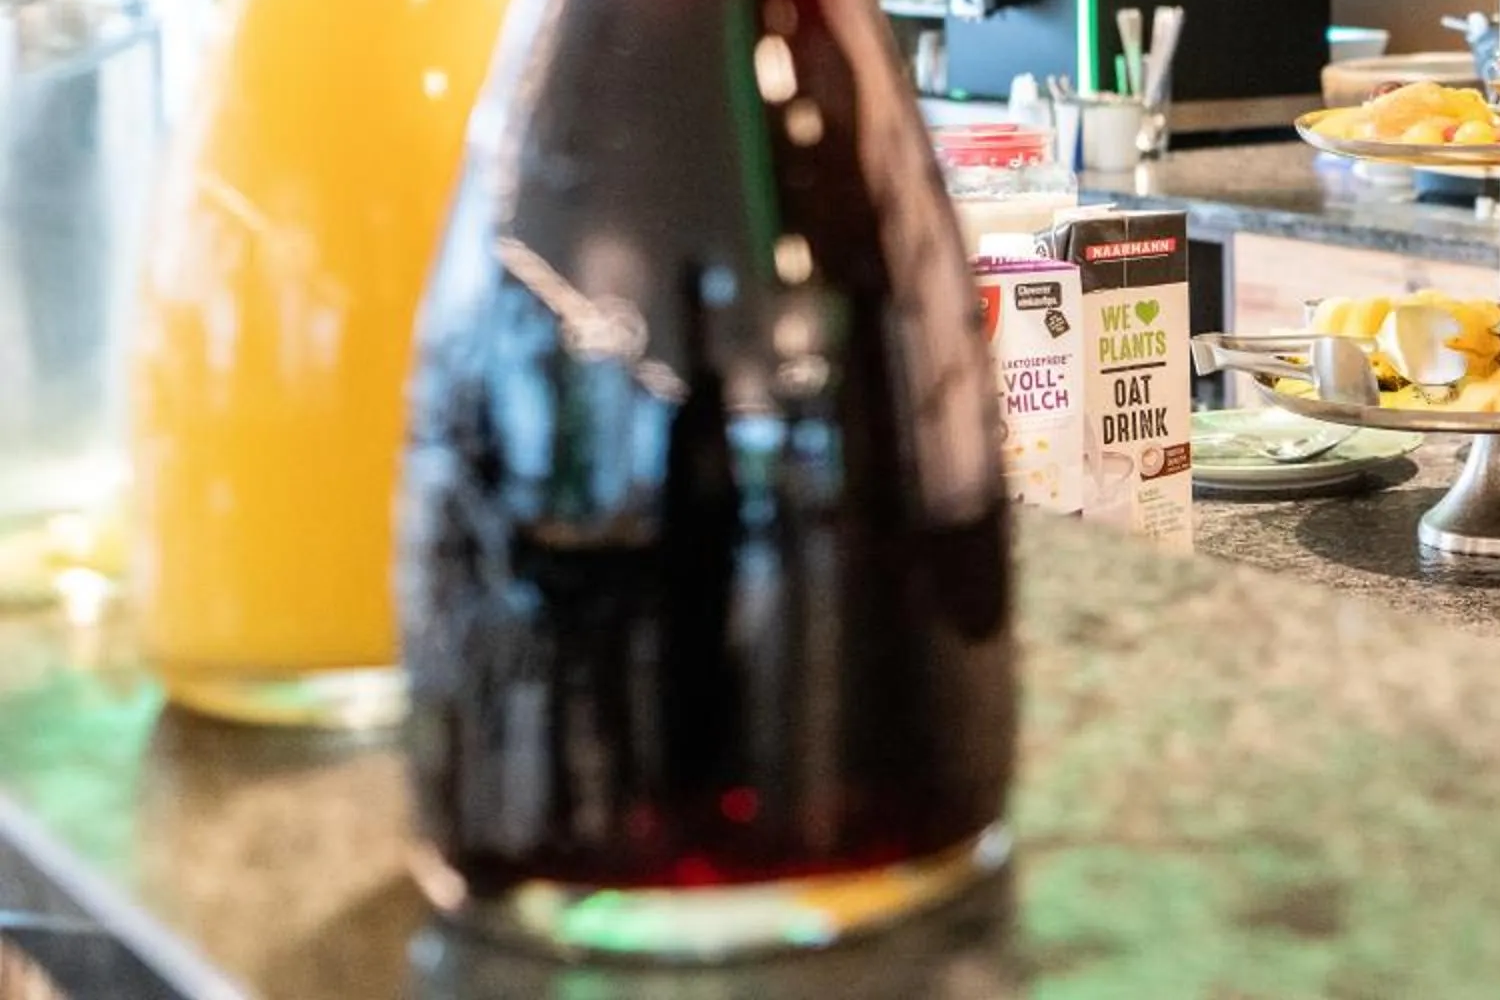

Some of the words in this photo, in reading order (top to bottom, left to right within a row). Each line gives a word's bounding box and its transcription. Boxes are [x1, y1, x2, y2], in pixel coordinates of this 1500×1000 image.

[1093, 240, 1169, 259] NAARMANN
[1101, 303, 1131, 331] WE
[1099, 330, 1167, 363] PLANTS
[1003, 369, 1065, 392] VOLL-
[1114, 375, 1152, 408] OAT
[1007, 389, 1069, 415] MILCH
[1103, 407, 1169, 445] DRINK
